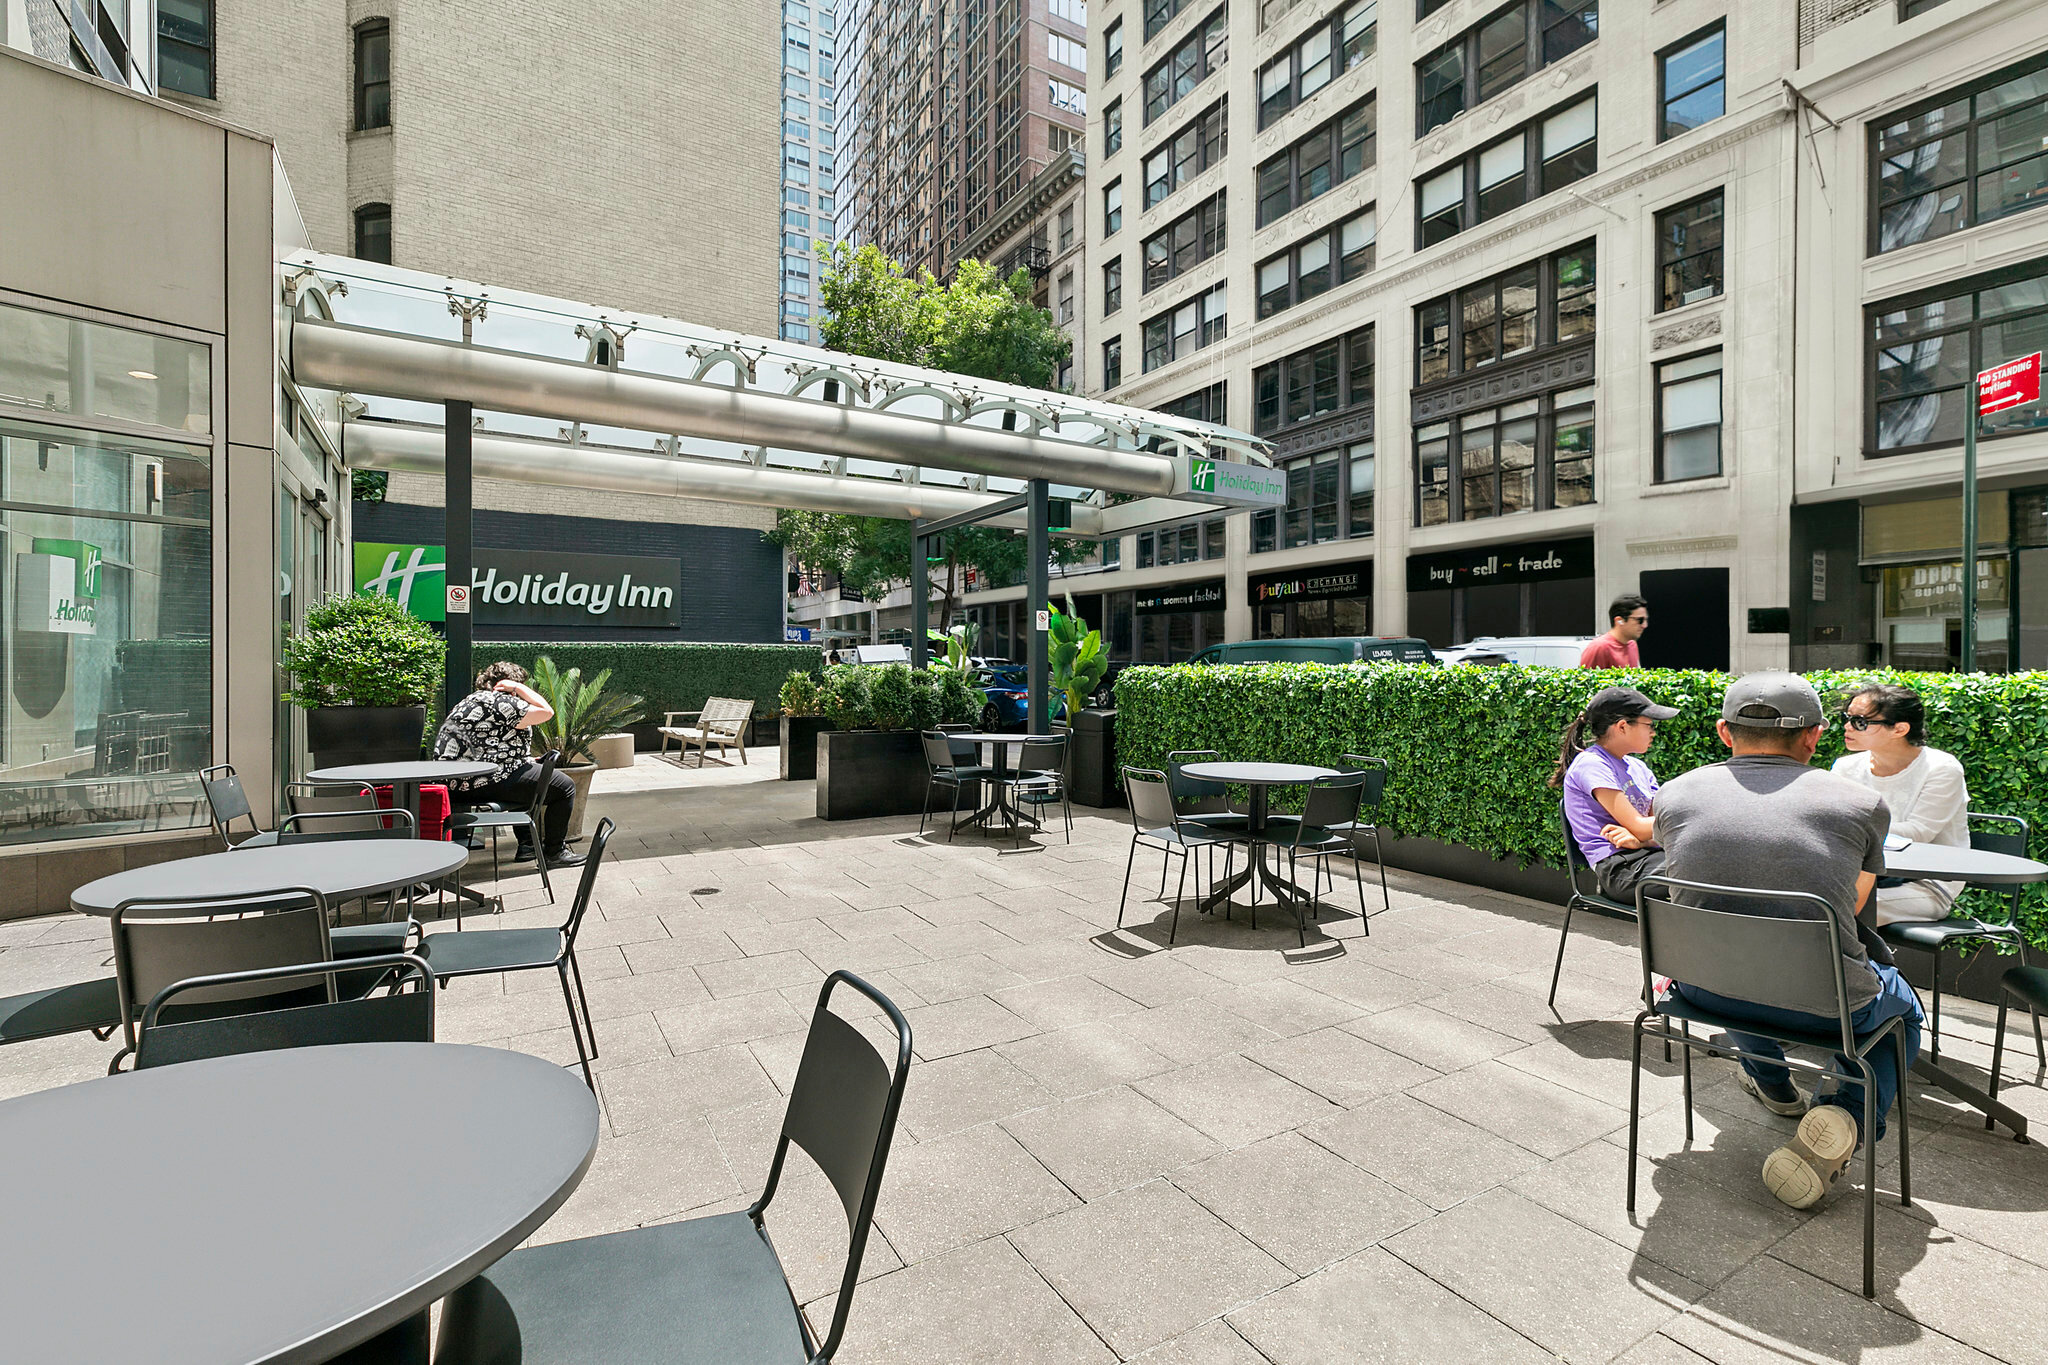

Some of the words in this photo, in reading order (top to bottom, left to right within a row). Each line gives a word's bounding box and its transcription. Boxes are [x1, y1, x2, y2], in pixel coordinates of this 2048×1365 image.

[1980, 375, 1992, 386] NO
[1992, 360, 2033, 382] STANDING
[1980, 379, 2012, 396] Anytime
[1219, 471, 1263, 495] Holiday
[1263, 478, 1283, 496] Inn
[1430, 566, 1454, 584] buy
[1472, 556, 1498, 576] sell
[1518, 550, 1563, 572] trade
[471, 567, 614, 615] Holiday
[618, 574, 673, 608] Inn
